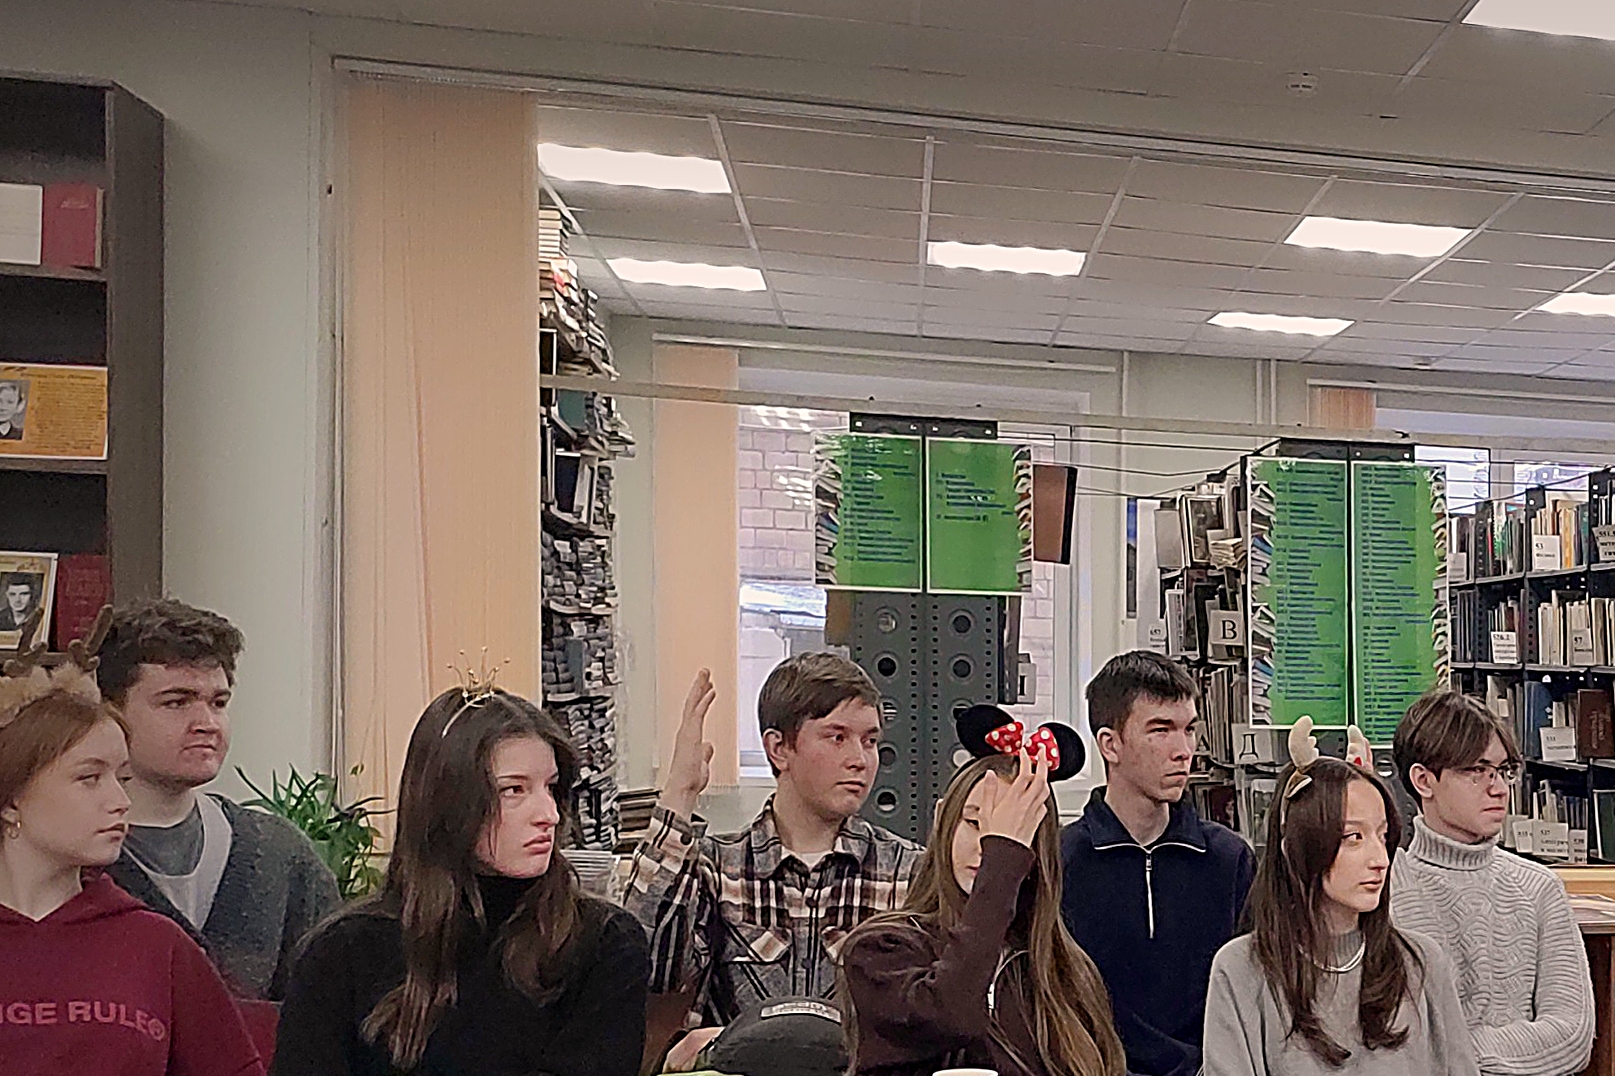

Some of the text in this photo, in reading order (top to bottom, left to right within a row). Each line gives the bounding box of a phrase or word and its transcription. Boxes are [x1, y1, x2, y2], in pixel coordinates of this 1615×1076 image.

[1221, 619, 1238, 640] В
[1195, 734, 1211, 751] А
[1239, 733, 1259, 760] Д
[0, 1002, 58, 1025] GE
